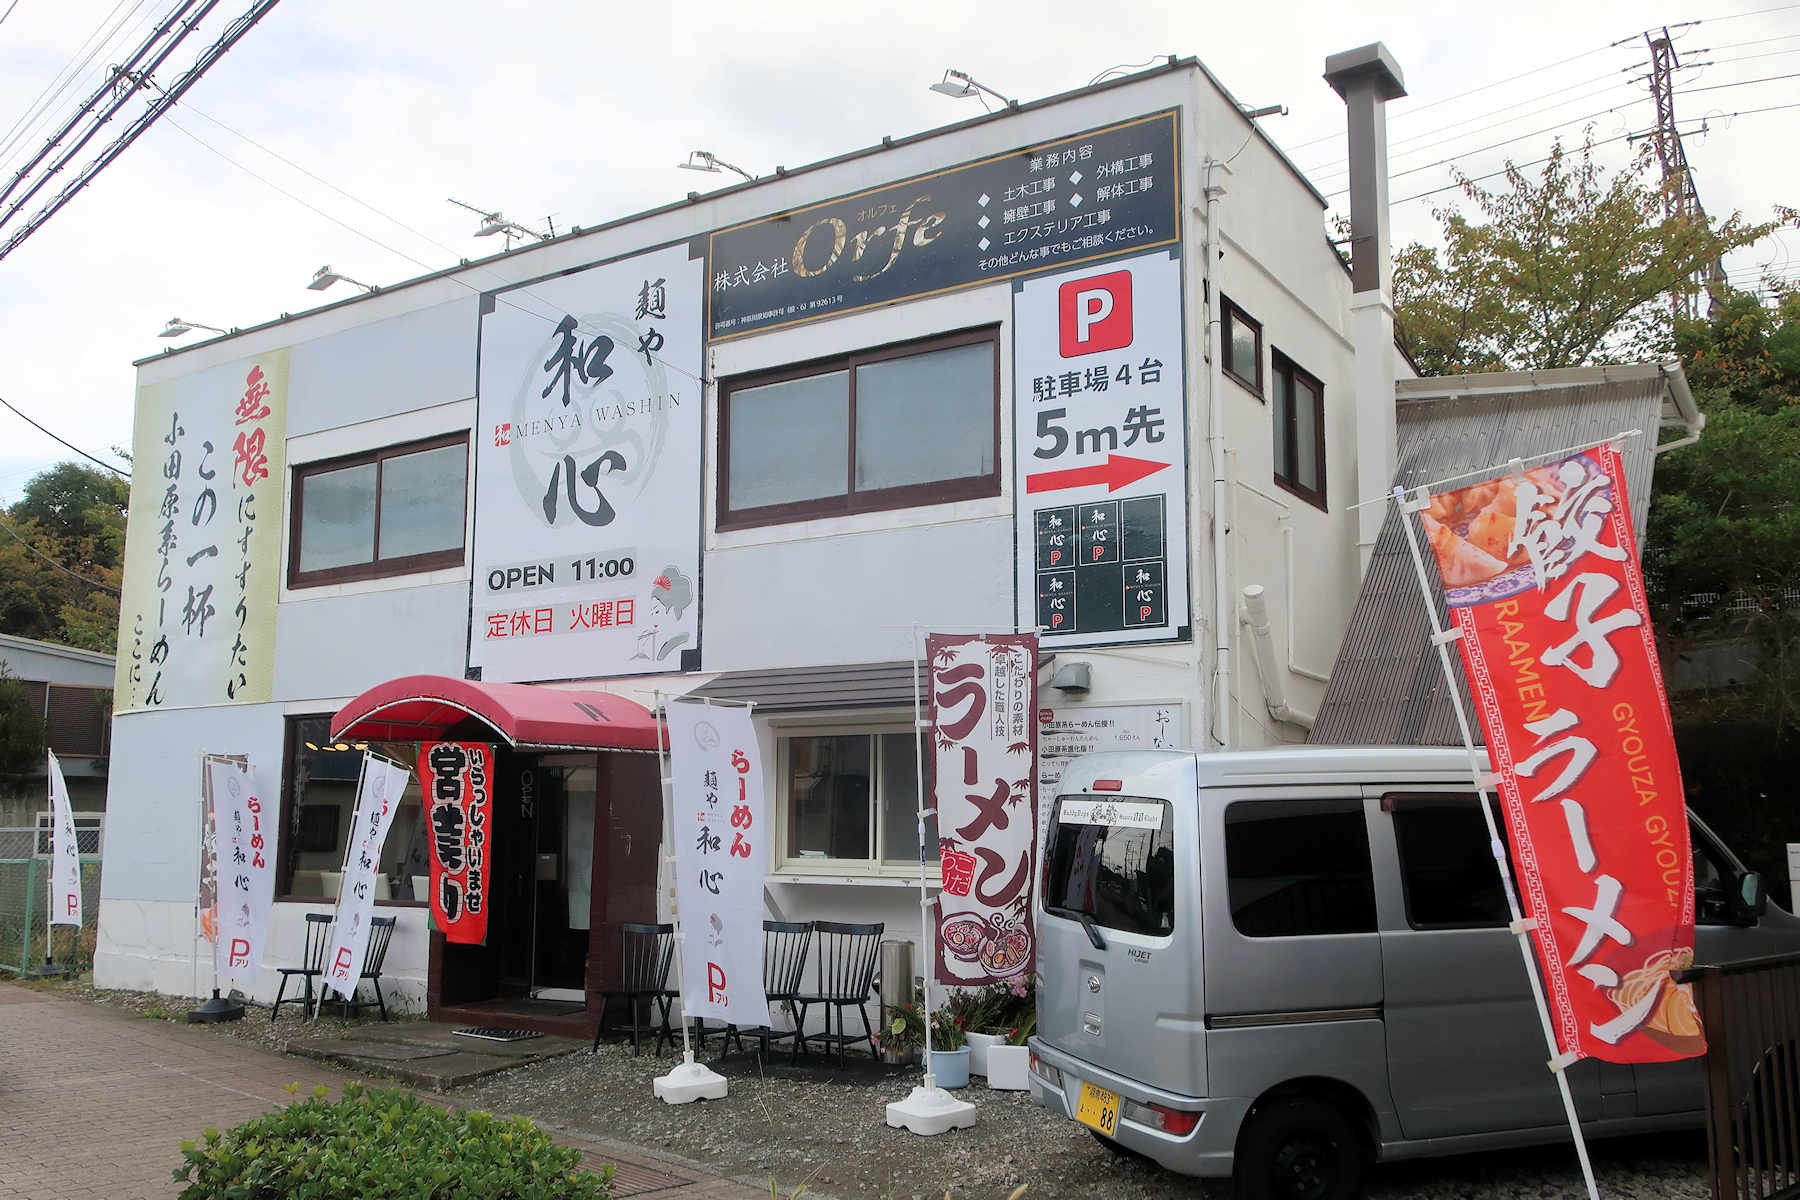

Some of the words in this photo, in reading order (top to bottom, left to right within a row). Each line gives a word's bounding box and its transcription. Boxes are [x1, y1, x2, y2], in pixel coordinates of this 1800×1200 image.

[1029, 144, 1094, 172] 業務内容
[1096, 153, 1154, 179] 外構工事
[857, 204, 898, 221] オルフェ
[1003, 177, 1056, 202] 土木工事
[1003, 199, 1056, 224] 擁壁工事
[1096, 176, 1154, 202] 解体工事
[792, 195, 947, 282] Orfe
[977, 224, 1155, 271] その他どんな事でもご相談ください。
[1004, 208, 1112, 245] エクステリア工事
[714, 257, 789, 292] 株式会社
[634, 278, 667, 367] 麺や
[515, 415, 583, 440] MENYA
[595, 391, 683, 423] WASHIN
[1033, 404, 1166, 461] 5m先
[146, 411, 185, 706] 小田原系らーめん
[182, 440, 219, 638] この一杯
[487, 562, 555, 592] OPEN
[571, 556, 635, 581] 11:00
[486, 607, 554, 639] 定休日
[568, 600, 635, 632] 火曜日
[1494, 600, 1550, 724] RAAMEN
[994, 653, 1007, 738] 卓越した職人技
[1012, 653, 1024, 737] こだわりの素材
[1507, 459, 1665, 1045] 餃子ラーメン
[1612, 702, 1658, 806] GYOUZA
[703, 769, 718, 810] 麺や
[729, 747, 754, 859] らーめん
[935, 662, 1029, 909] ラーメン
[247, 796, 265, 869] らーめん
[465, 747, 487, 914] いらっしゃいませ
[229, 938, 250, 967] P
[1127, 948, 1152, 960] HIJET
[707, 961, 726, 1003] P
